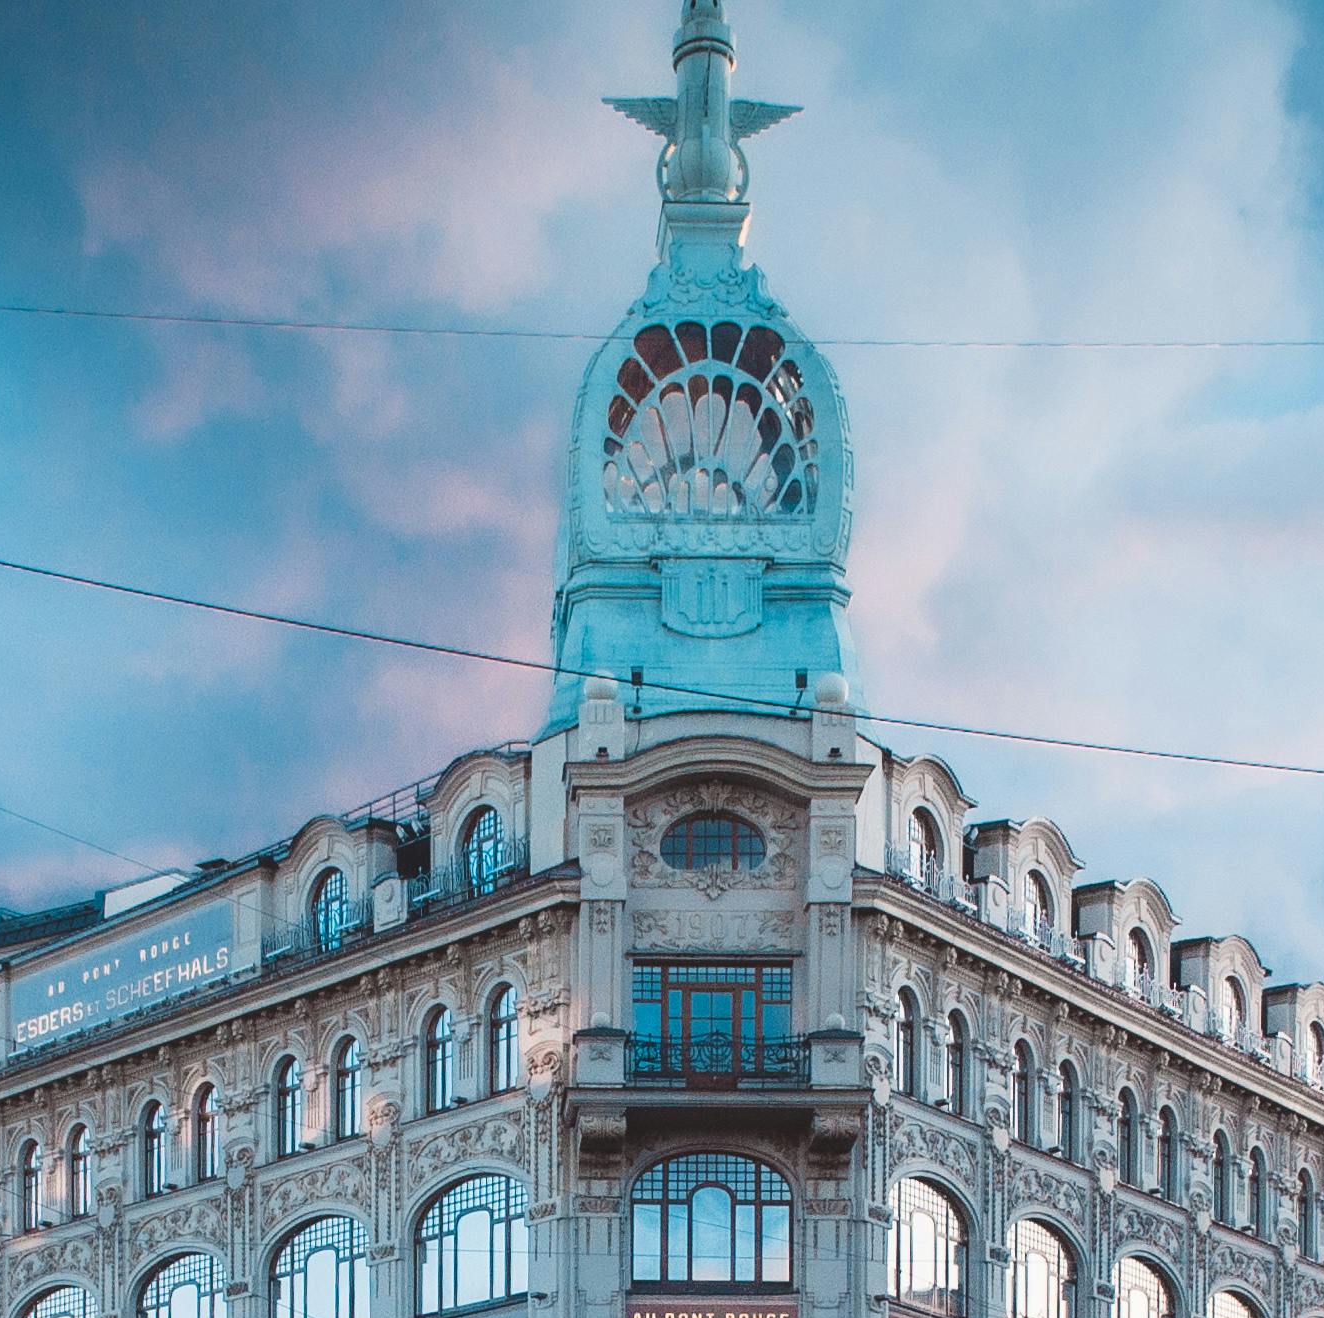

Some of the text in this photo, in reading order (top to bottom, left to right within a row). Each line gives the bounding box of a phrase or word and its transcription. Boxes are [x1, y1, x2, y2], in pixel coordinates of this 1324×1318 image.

[17, 1001, 83, 1043] ESDERS
[106, 947, 229, 1010] SCHEEFHALS
[83, 959, 120, 984] PONT
[139, 932, 191, 961] ROUGE
